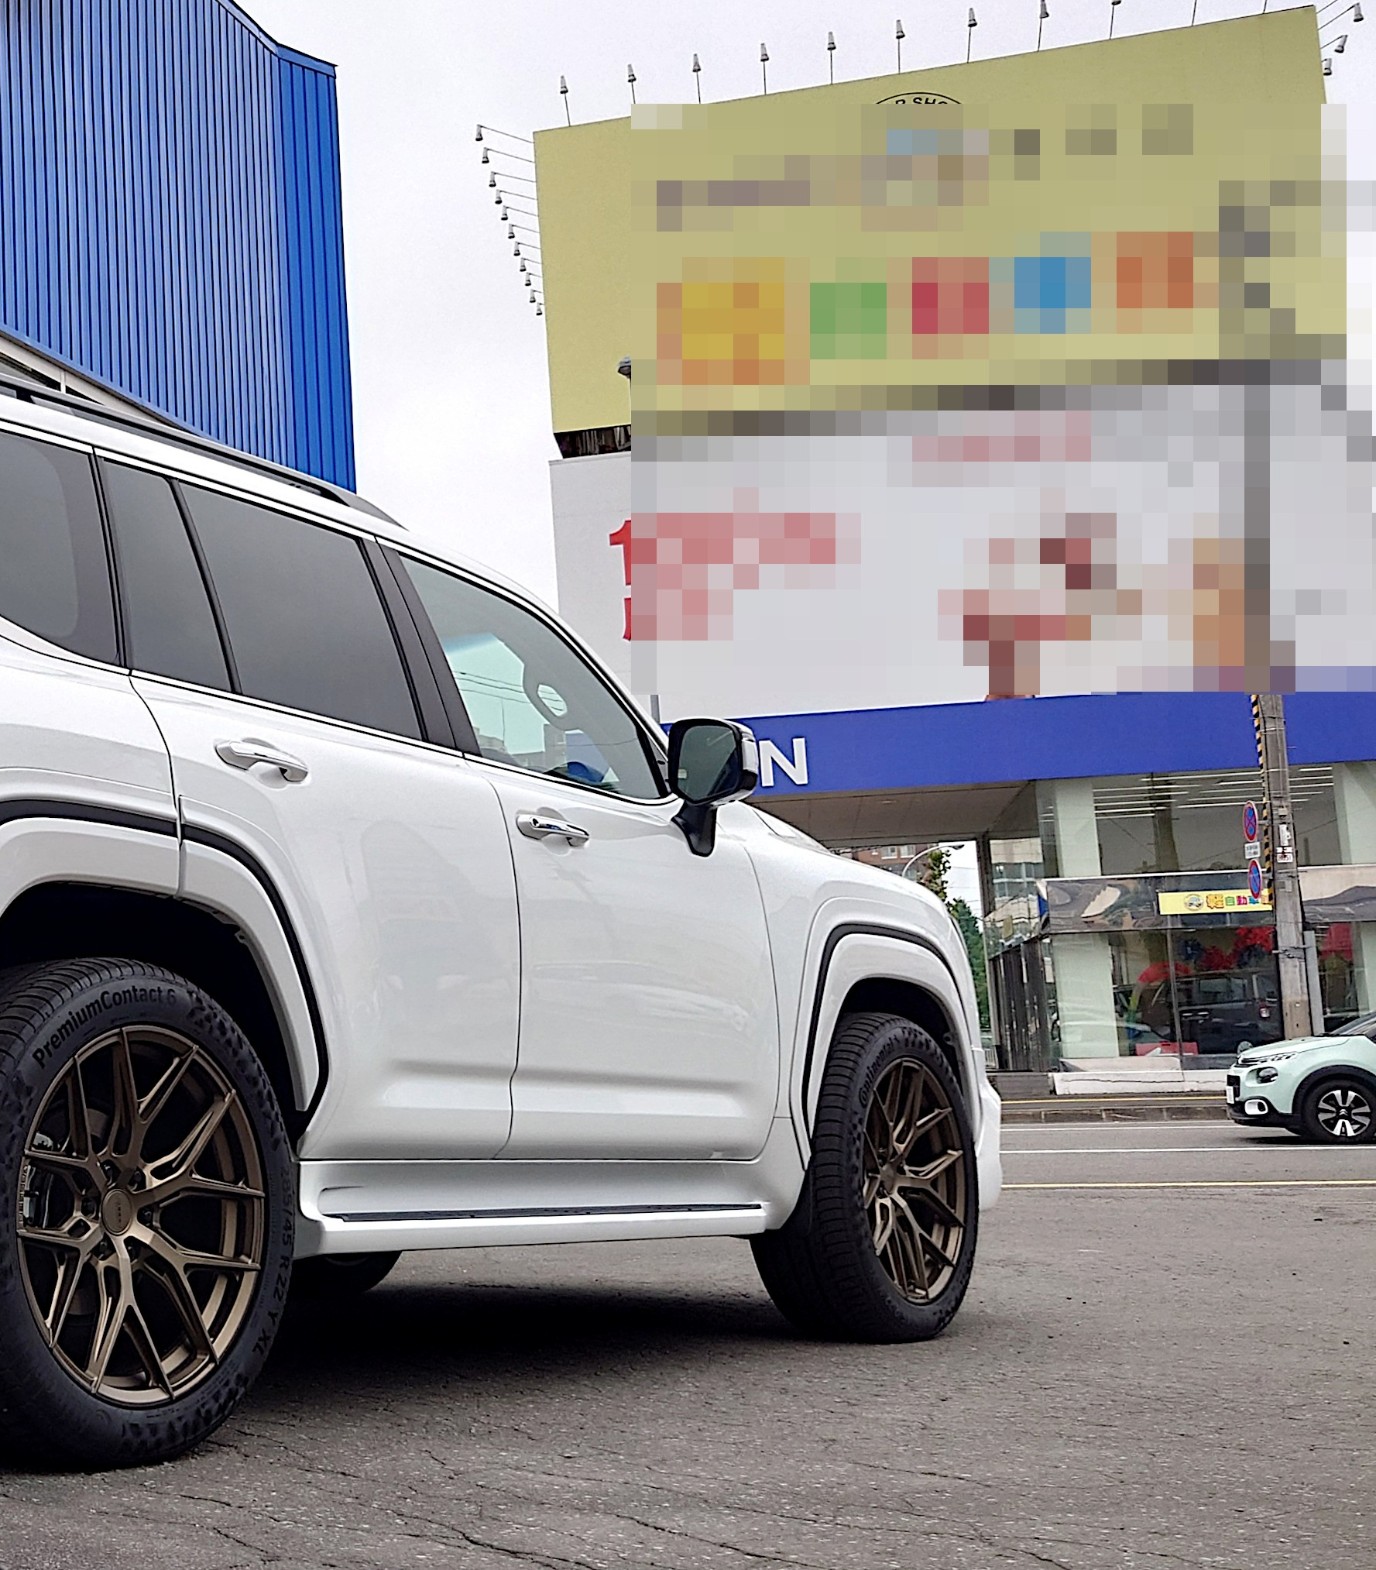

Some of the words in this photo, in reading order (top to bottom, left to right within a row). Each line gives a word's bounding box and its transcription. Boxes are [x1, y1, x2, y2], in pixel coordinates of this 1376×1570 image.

[32, 985, 163, 1069] PremiumContact
[166, 988, 178, 1007] 6
[858, 1036, 894, 1109] Continental
